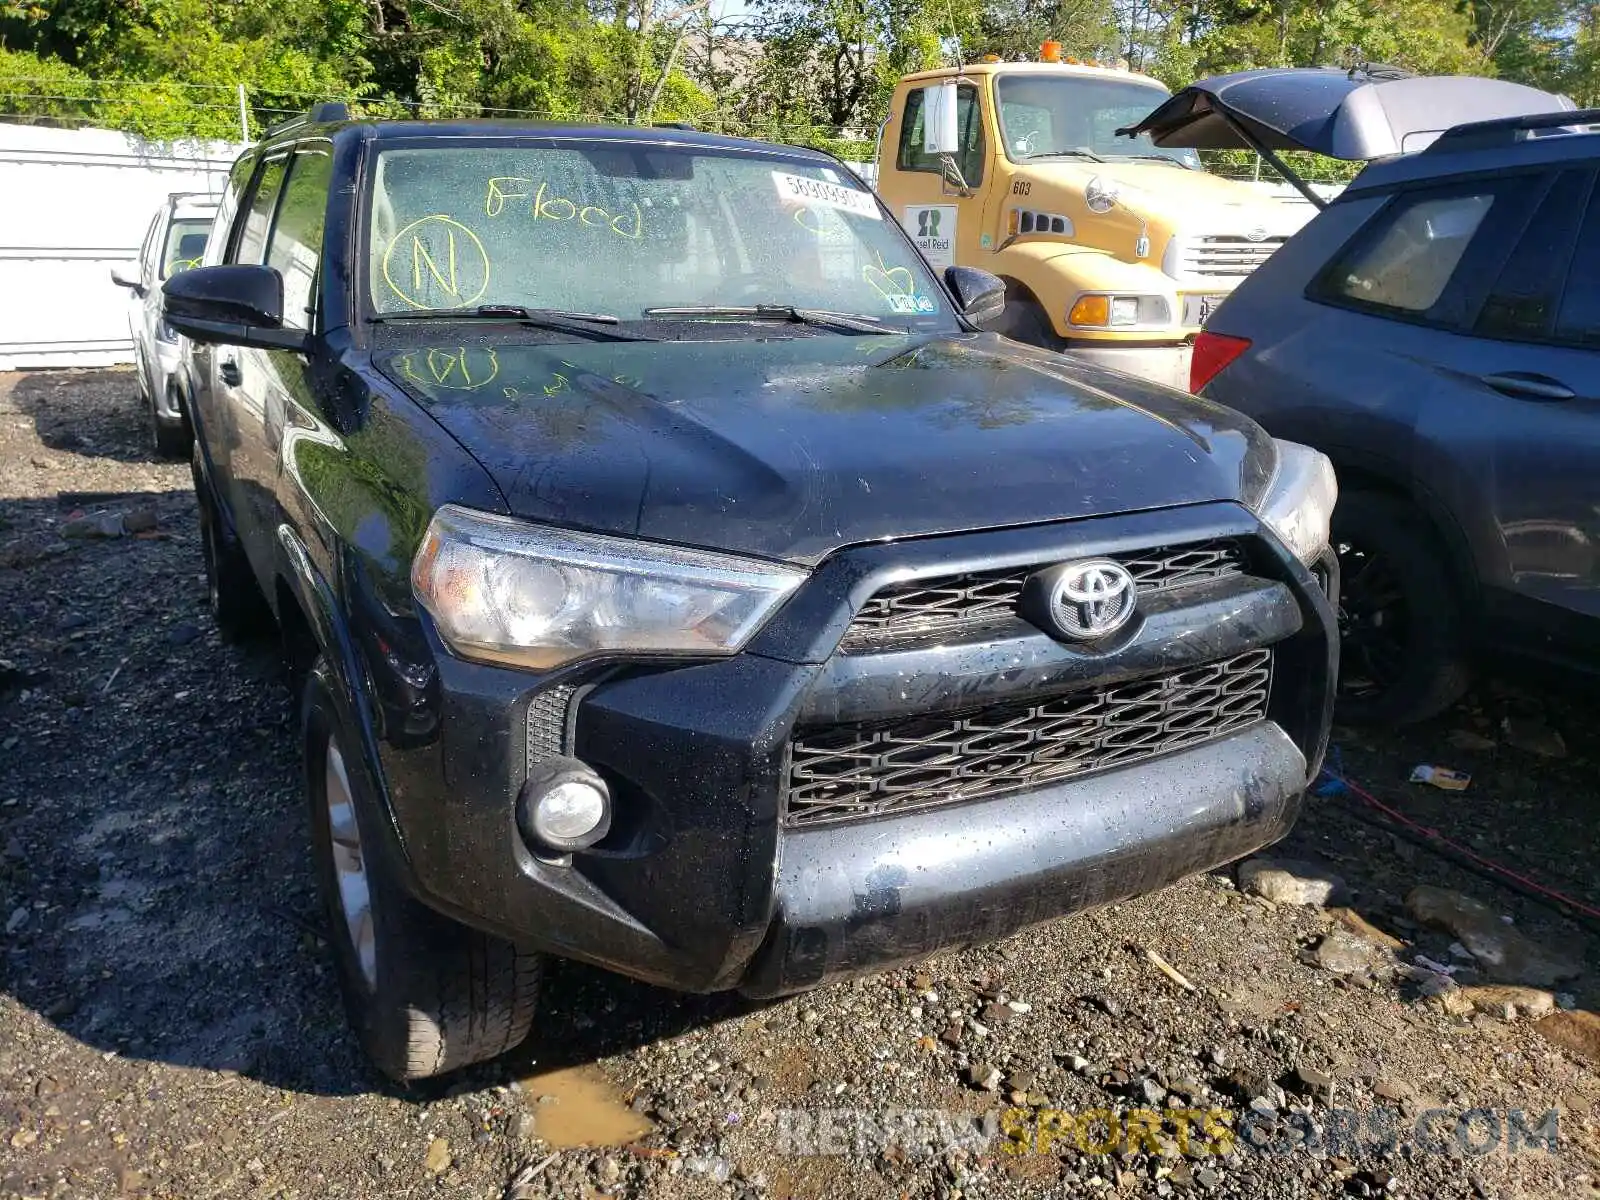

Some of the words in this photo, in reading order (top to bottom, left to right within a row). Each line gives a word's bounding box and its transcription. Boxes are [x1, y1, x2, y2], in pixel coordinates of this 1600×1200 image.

[486, 177, 642, 240] Flood
[786, 176, 867, 210] 5690990
[1013, 181, 1032, 196] 603
[413, 228, 458, 297] N
